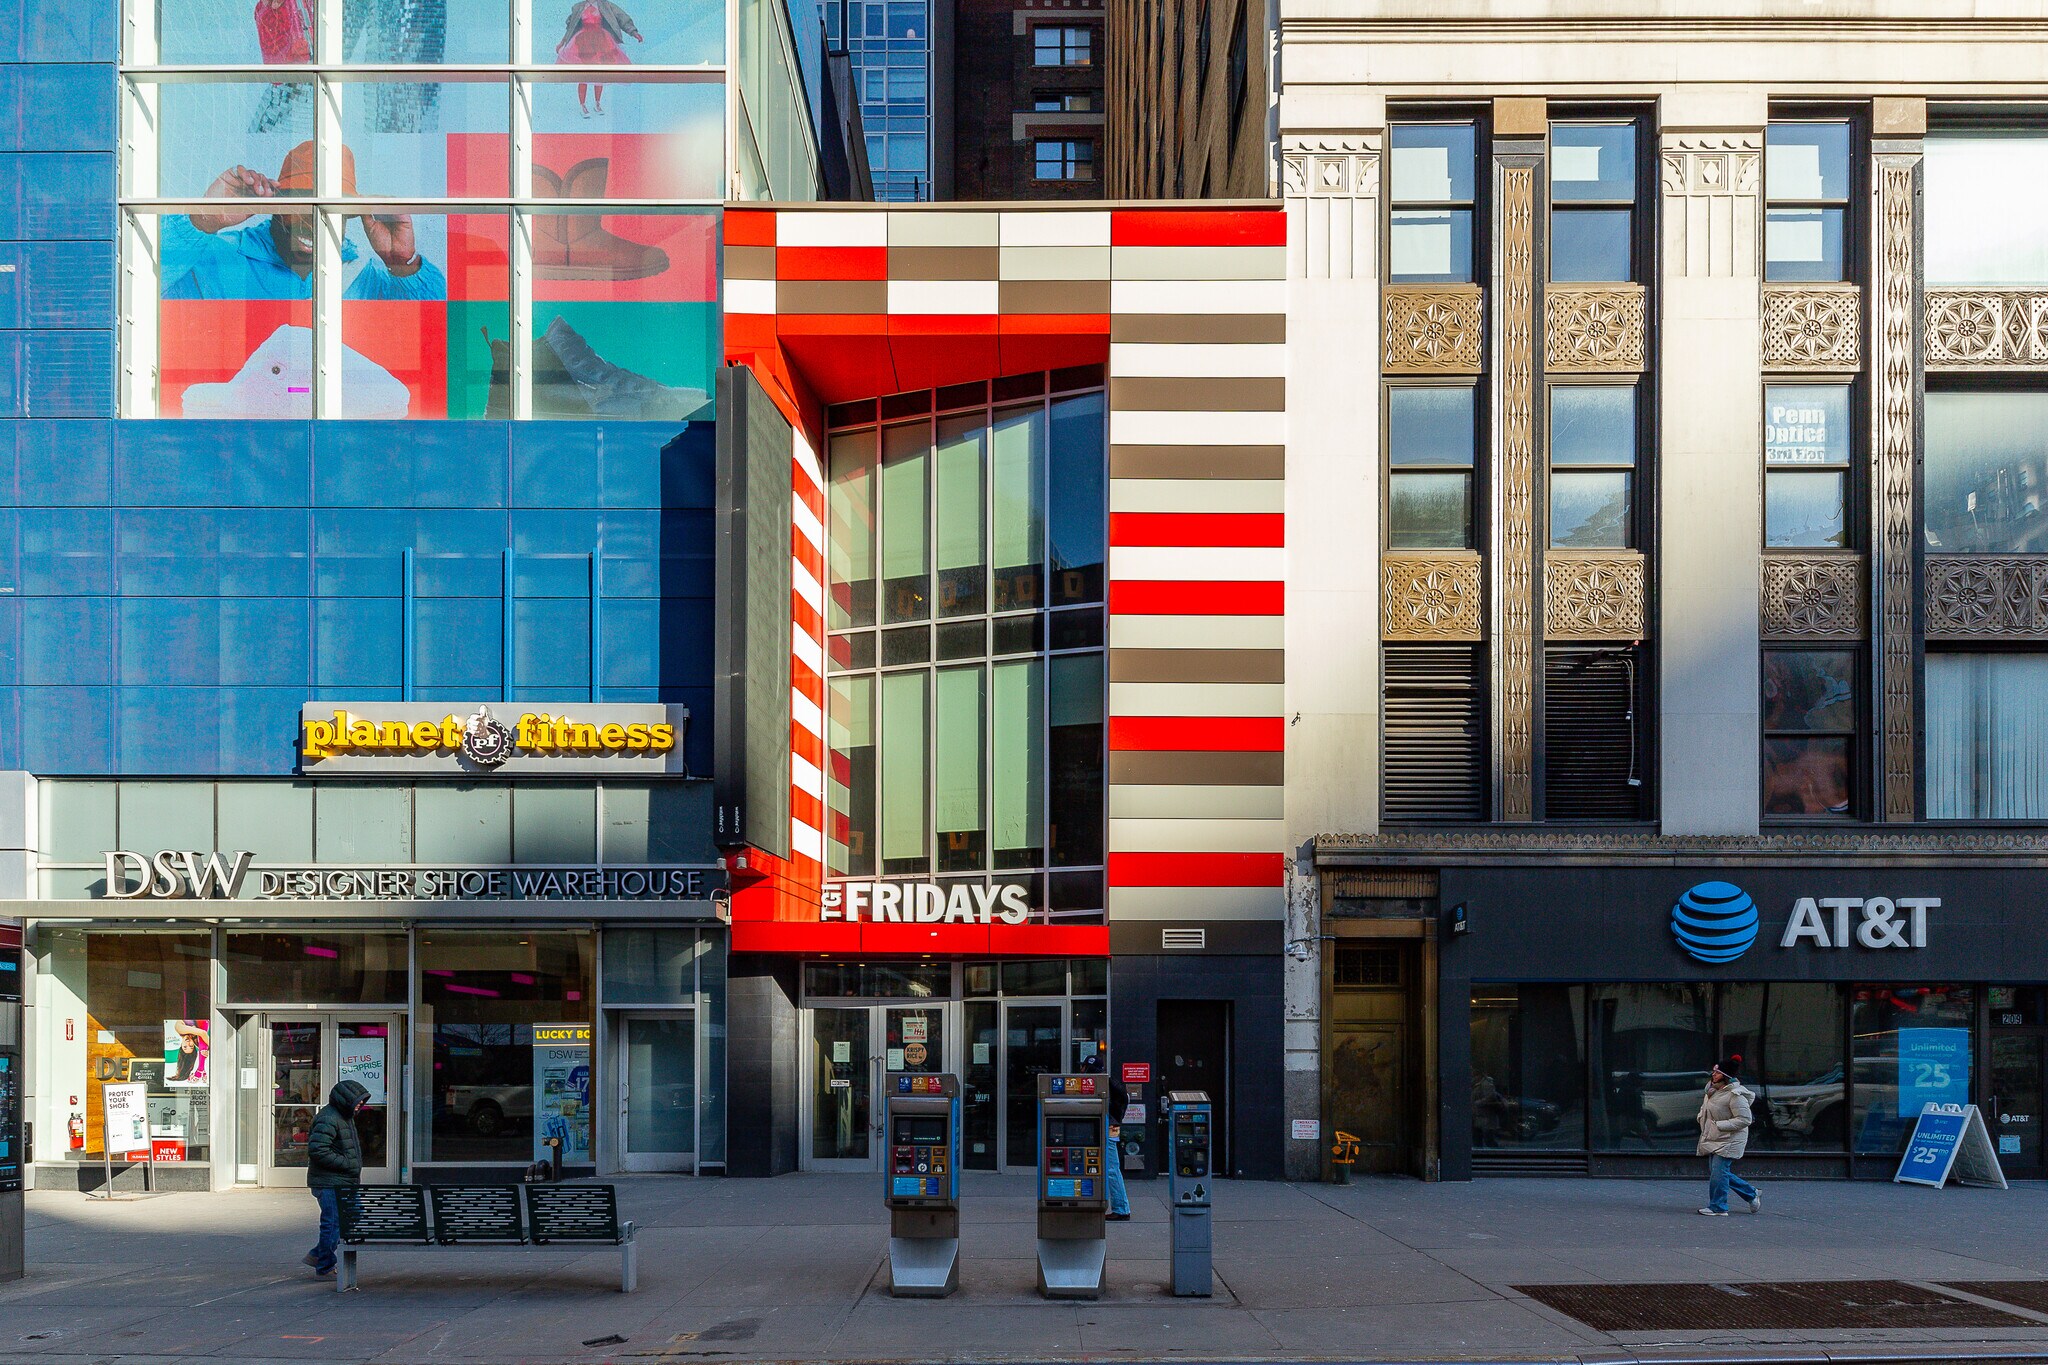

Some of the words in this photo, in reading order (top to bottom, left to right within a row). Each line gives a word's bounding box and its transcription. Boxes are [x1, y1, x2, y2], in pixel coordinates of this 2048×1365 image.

[1773, 406, 1825, 424] Penn
[303, 710, 457, 756] planet
[474, 734, 499, 750] pf
[516, 713, 675, 750] fitness
[99, 850, 255, 898] DSW
[260, 870, 413, 895] DESIGNER
[421, 870, 501, 895] SHOE
[513, 870, 701, 895] WAREHOUSE
[820, 883, 842, 921] TGI
[845, 882, 1030, 925] FRIDAYS
[1780, 896, 1942, 949] AT&T
[2002, 1013, 2022, 1025] 209
[535, 1029, 573, 1040] LUCKY
[1910, 1043, 1957, 1052] Unlimited
[342, 1055, 358, 1064] LET
[360, 1054, 372, 1063] US
[549, 1050, 573, 1059] DSW
[341, 1060, 383, 1075] SURPRISE
[362, 1071, 380, 1080] YOU
[1908, 1063, 1951, 1089] $25
[575, 1077, 590, 1092] 17
[108, 1090, 134, 1098] PROTECT
[2010, 1115, 2030, 1123] AT&T
[1917, 1132, 1956, 1142] UNLIMITED
[1912, 1146, 1939, 1164] $25
